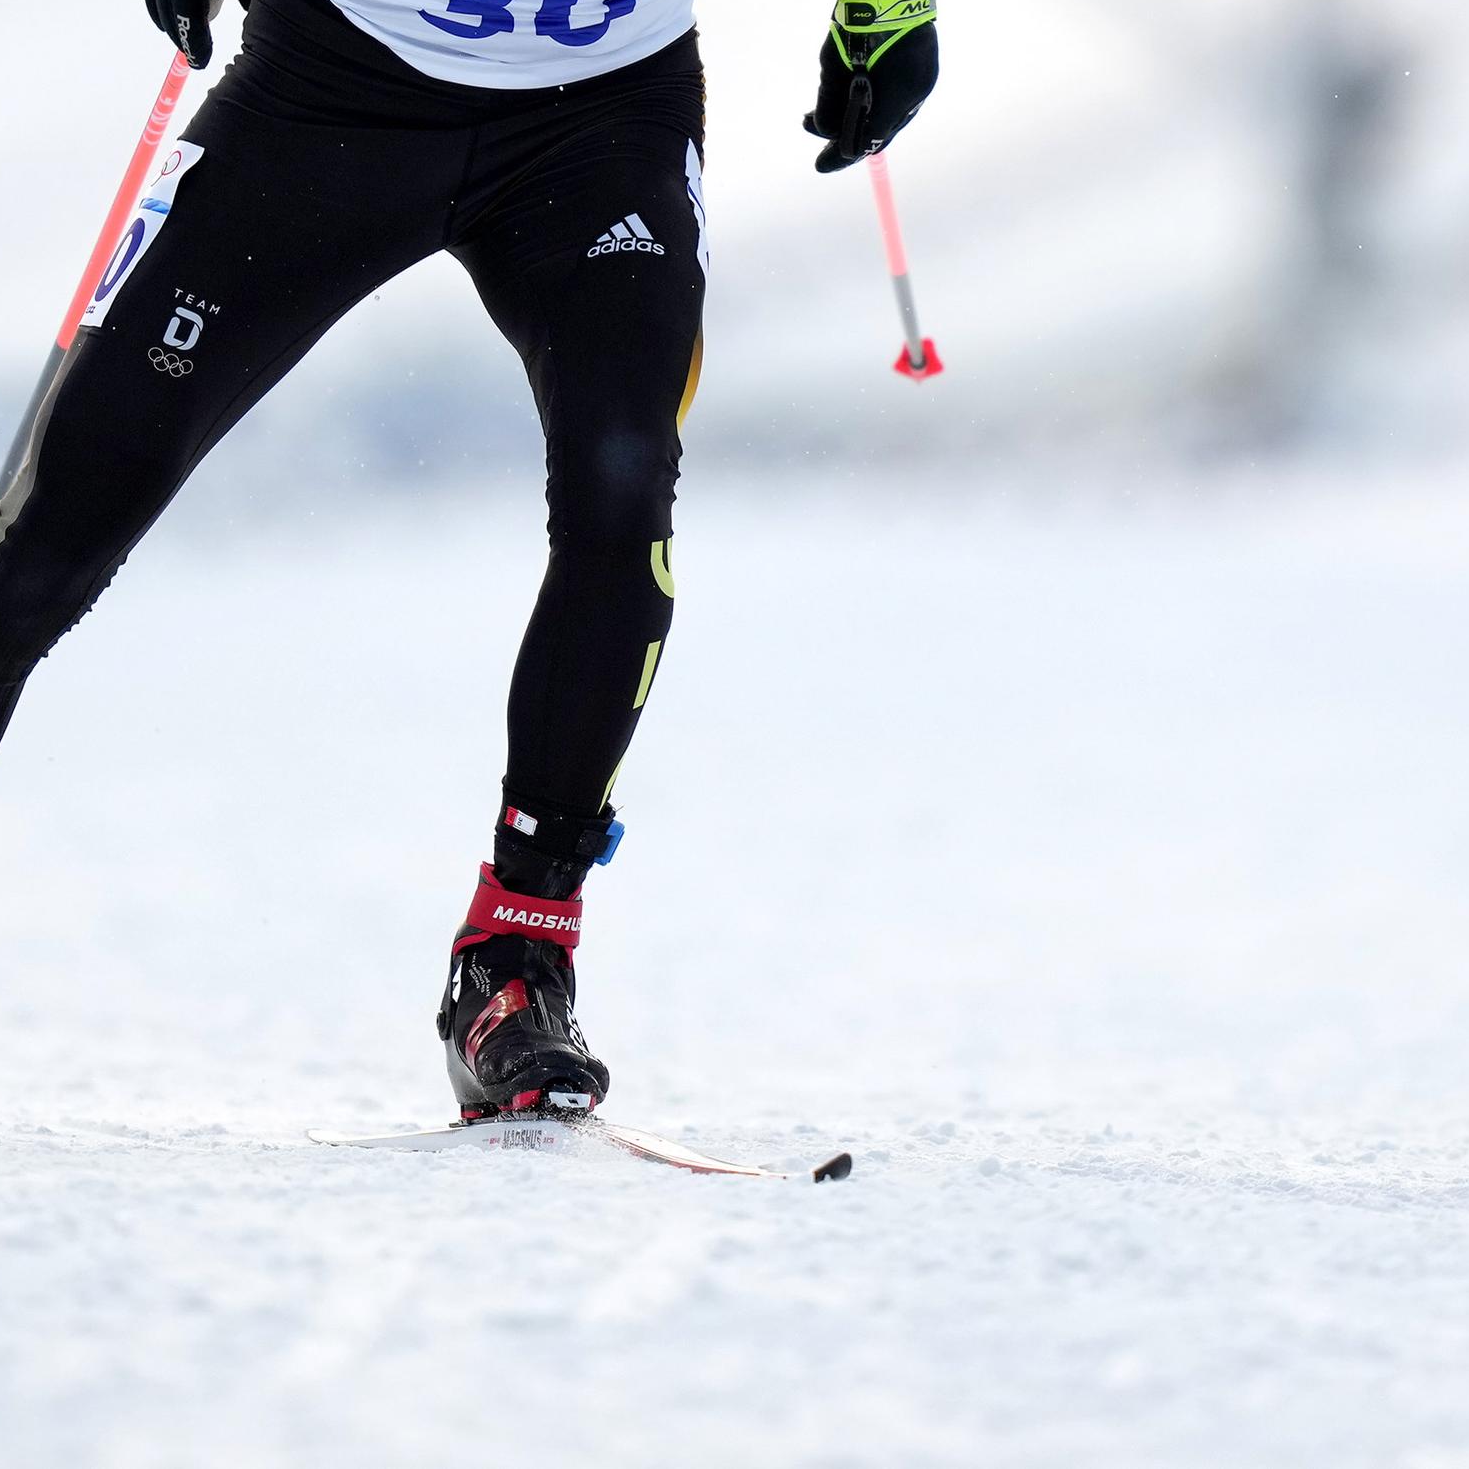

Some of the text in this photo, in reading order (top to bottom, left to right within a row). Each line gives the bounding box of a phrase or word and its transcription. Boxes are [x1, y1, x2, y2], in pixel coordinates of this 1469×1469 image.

[587, 237, 665, 258] adidas
[174, 288, 222, 316] TEAM
[163, 306, 204, 351] D
